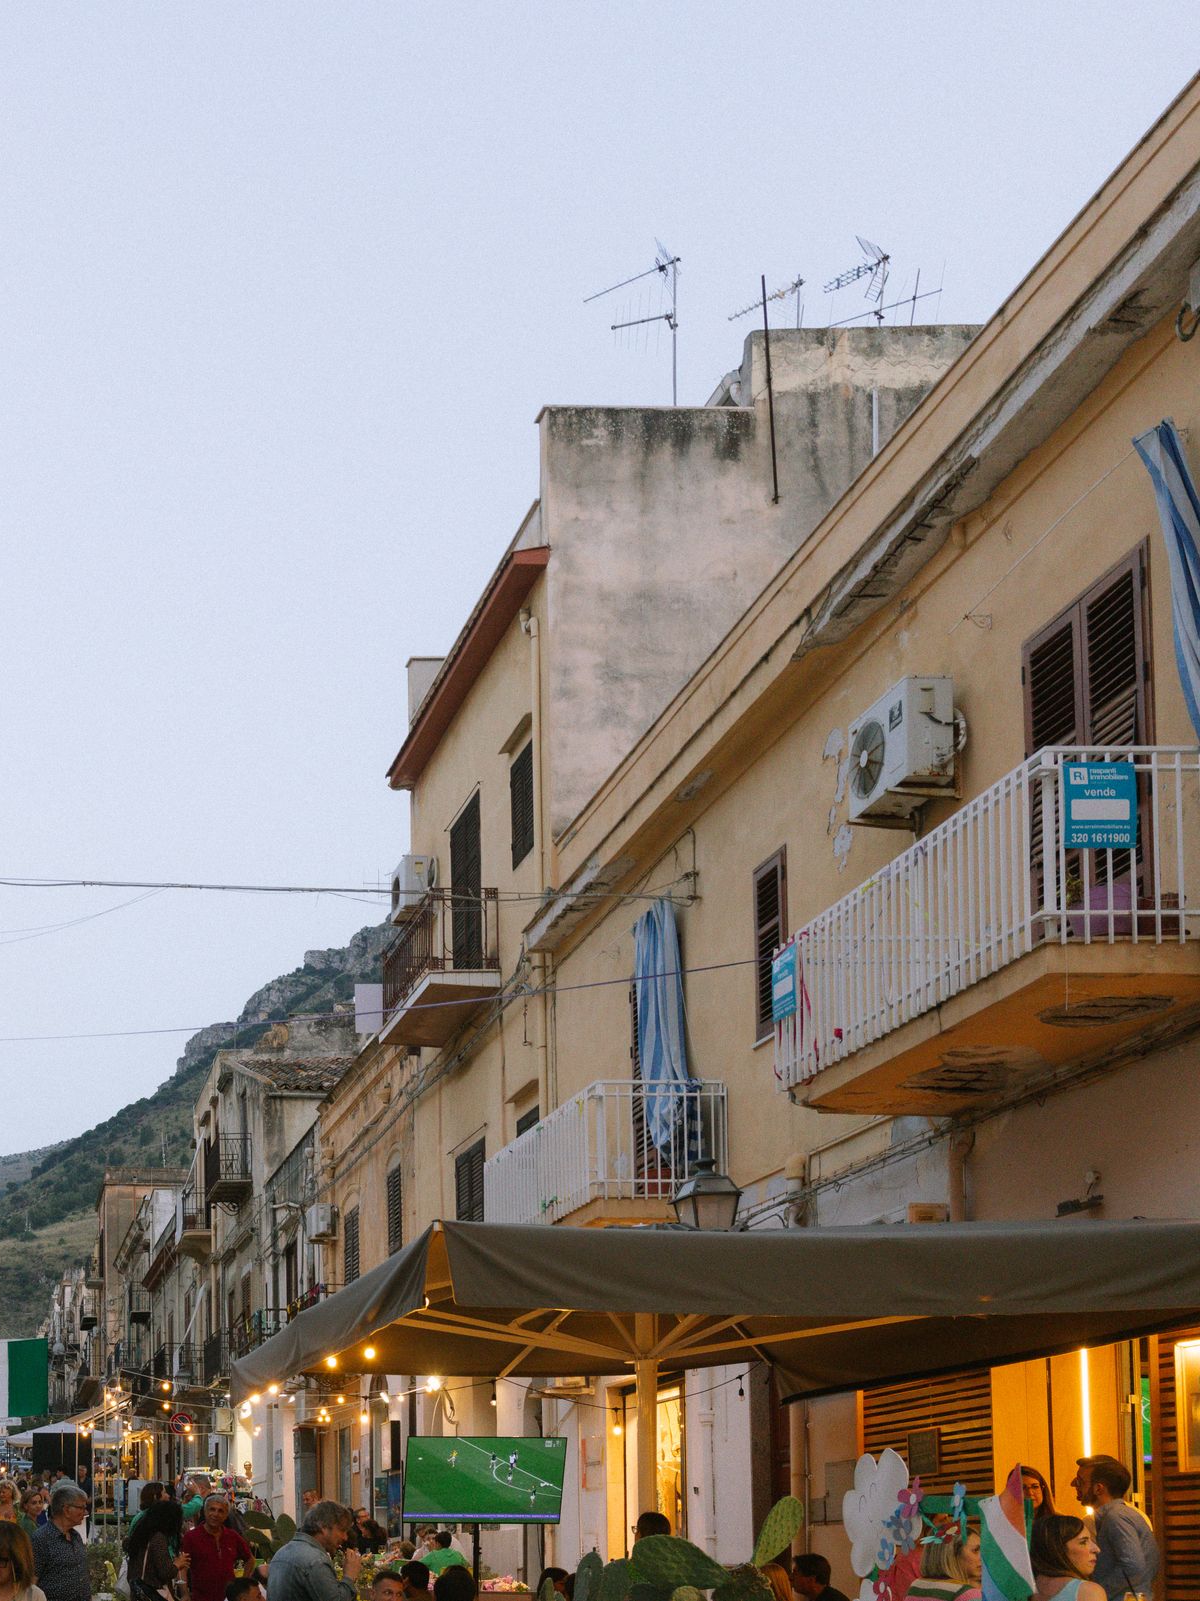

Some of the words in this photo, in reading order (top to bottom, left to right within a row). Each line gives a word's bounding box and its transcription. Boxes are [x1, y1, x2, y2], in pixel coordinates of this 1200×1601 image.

[1089, 773, 1129, 781] immobiliare
[1084, 787, 1116, 797] vende
[1071, 833, 1088, 843] 320
[1091, 833, 1130, 843] 1611900
